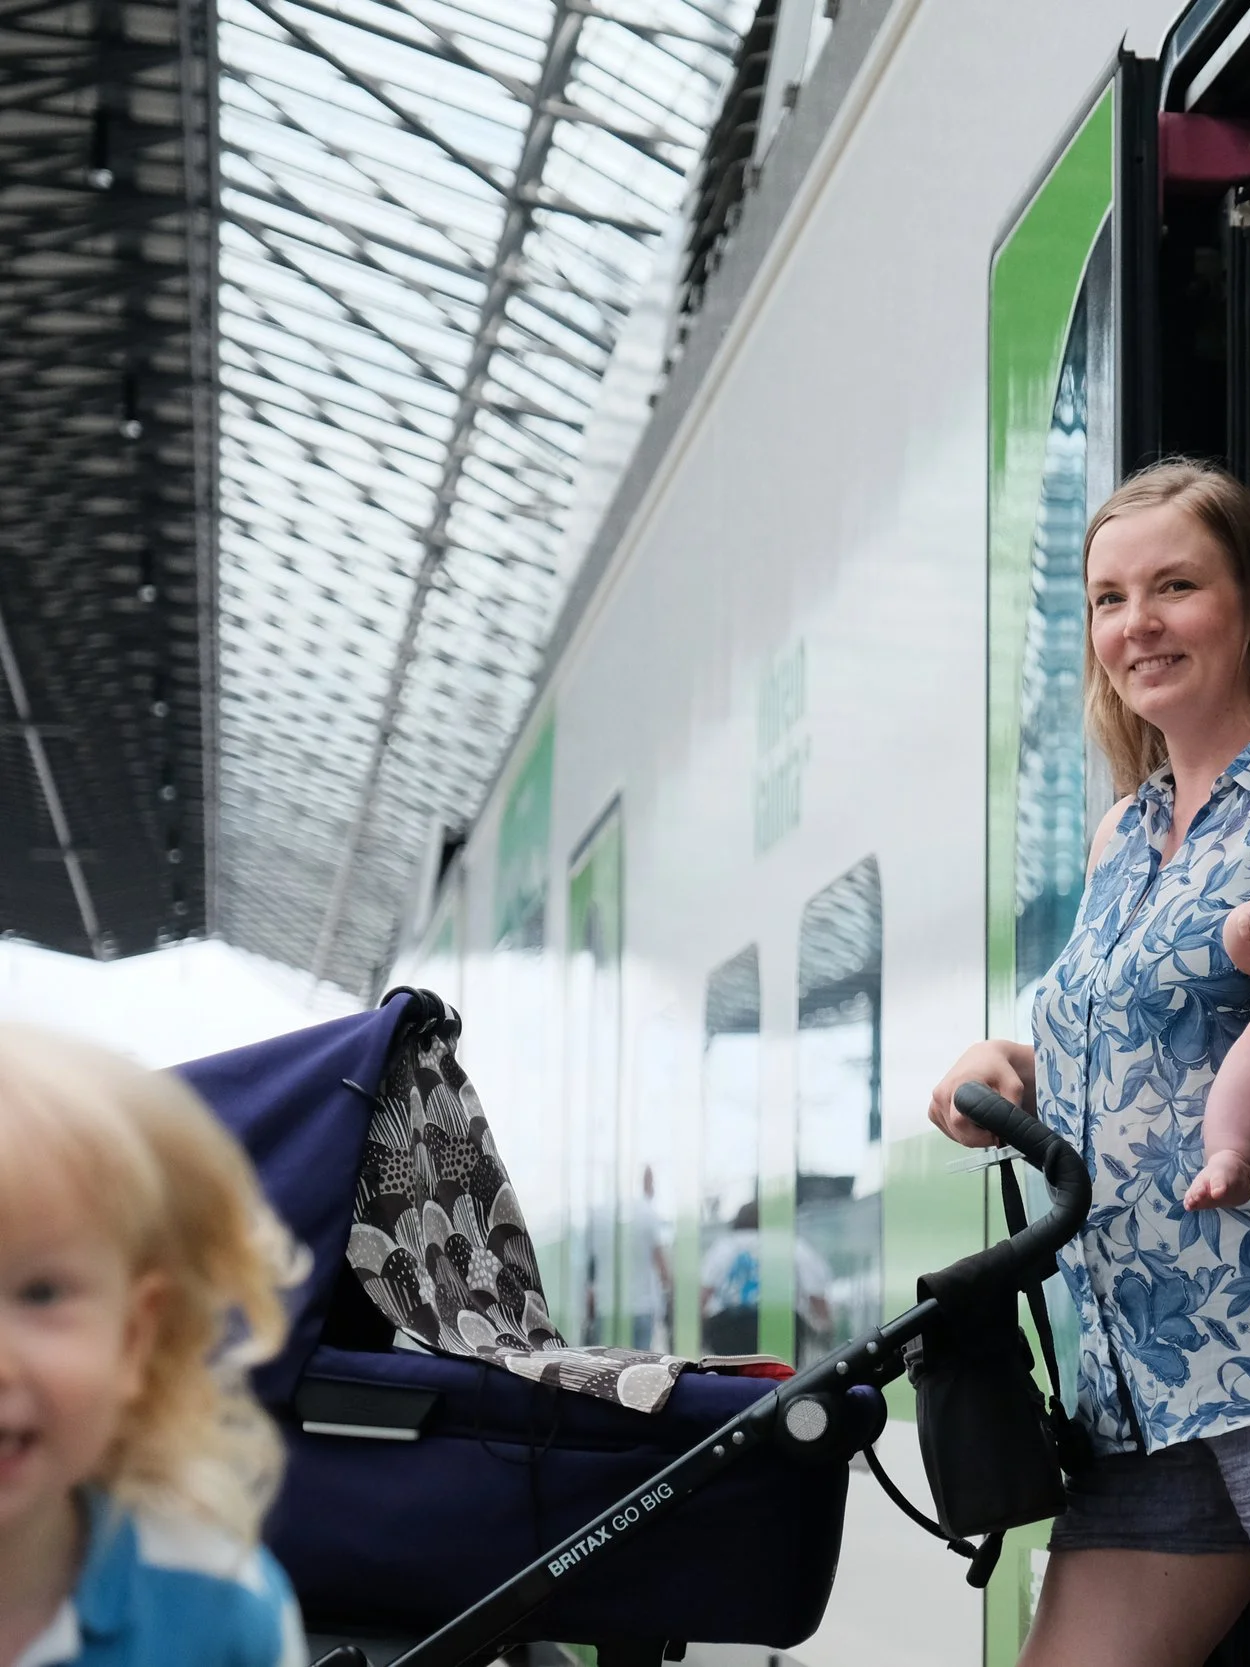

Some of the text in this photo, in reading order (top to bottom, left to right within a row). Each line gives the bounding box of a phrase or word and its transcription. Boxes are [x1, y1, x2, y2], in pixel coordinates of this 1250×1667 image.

[548, 1482, 674, 1577] BRITAX GO BIG
